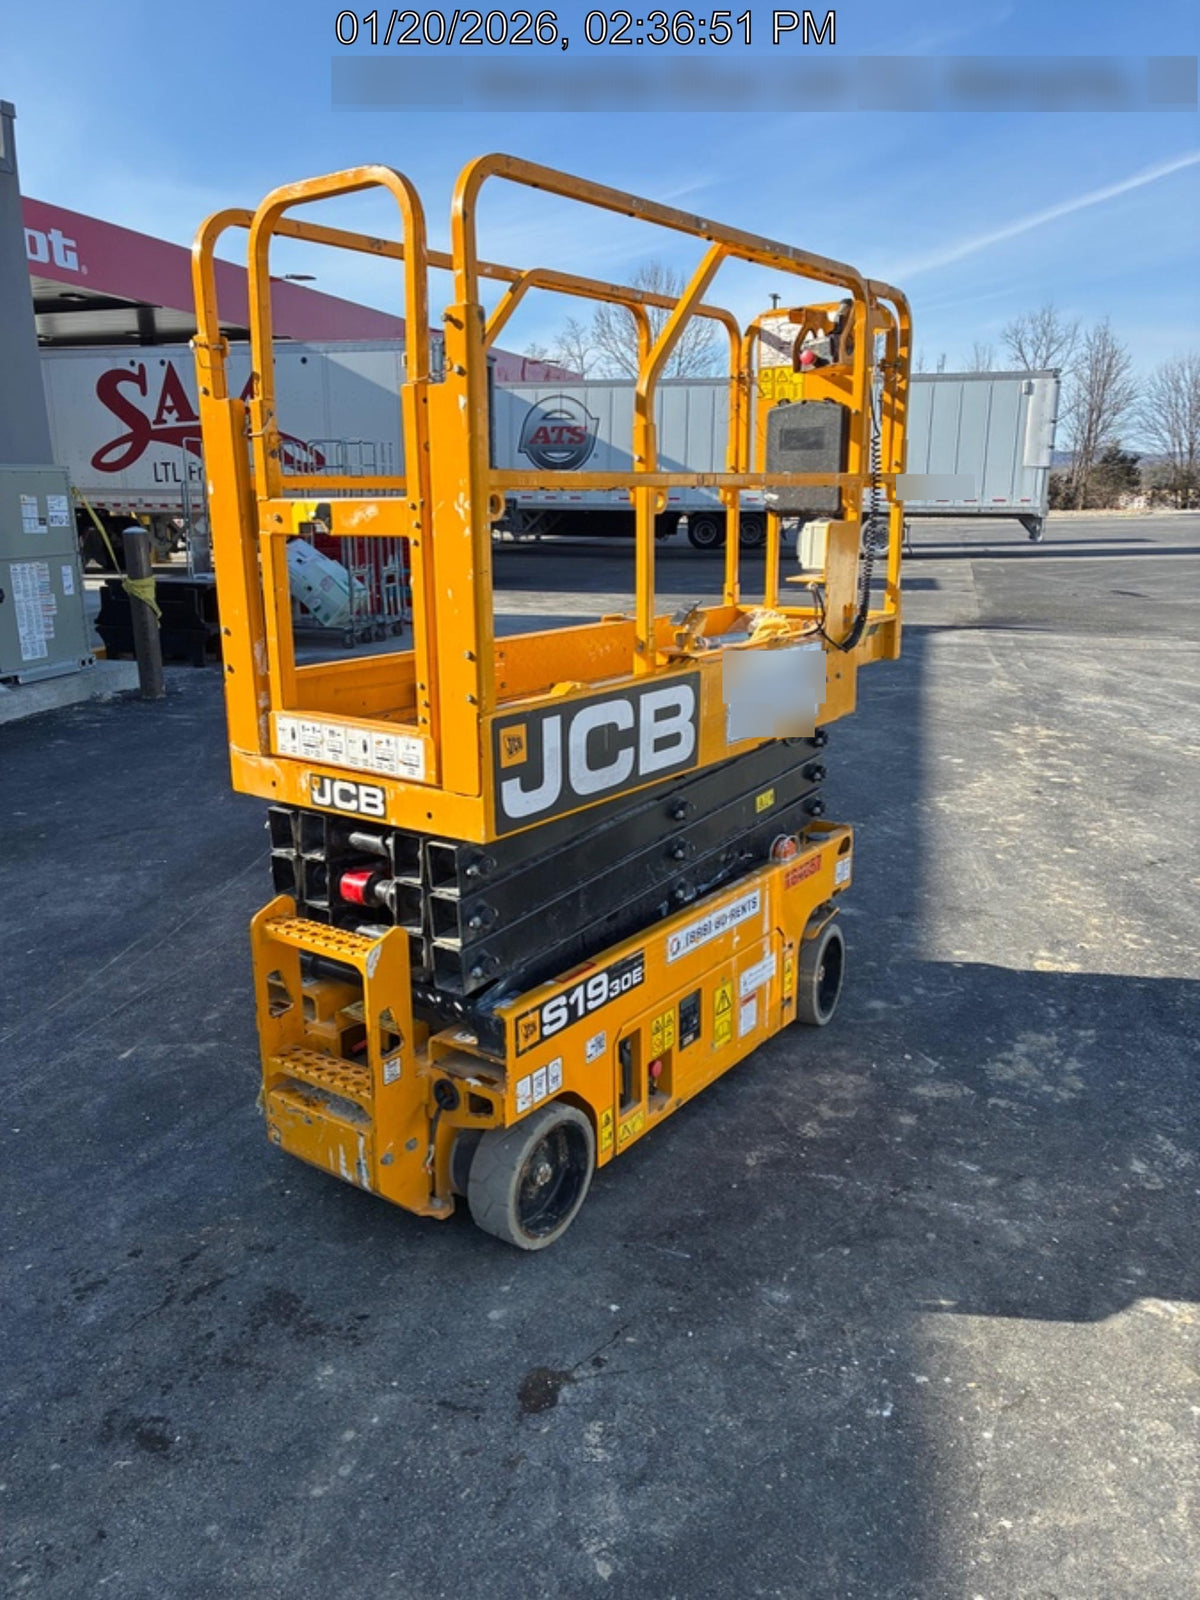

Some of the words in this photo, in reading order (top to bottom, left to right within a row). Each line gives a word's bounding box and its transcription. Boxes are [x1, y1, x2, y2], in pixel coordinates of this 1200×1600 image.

[528, 425, 588, 445] ATS
[154, 461, 182, 482] LTL
[501, 684, 696, 819] JCB
[312, 777, 385, 816] JCB
